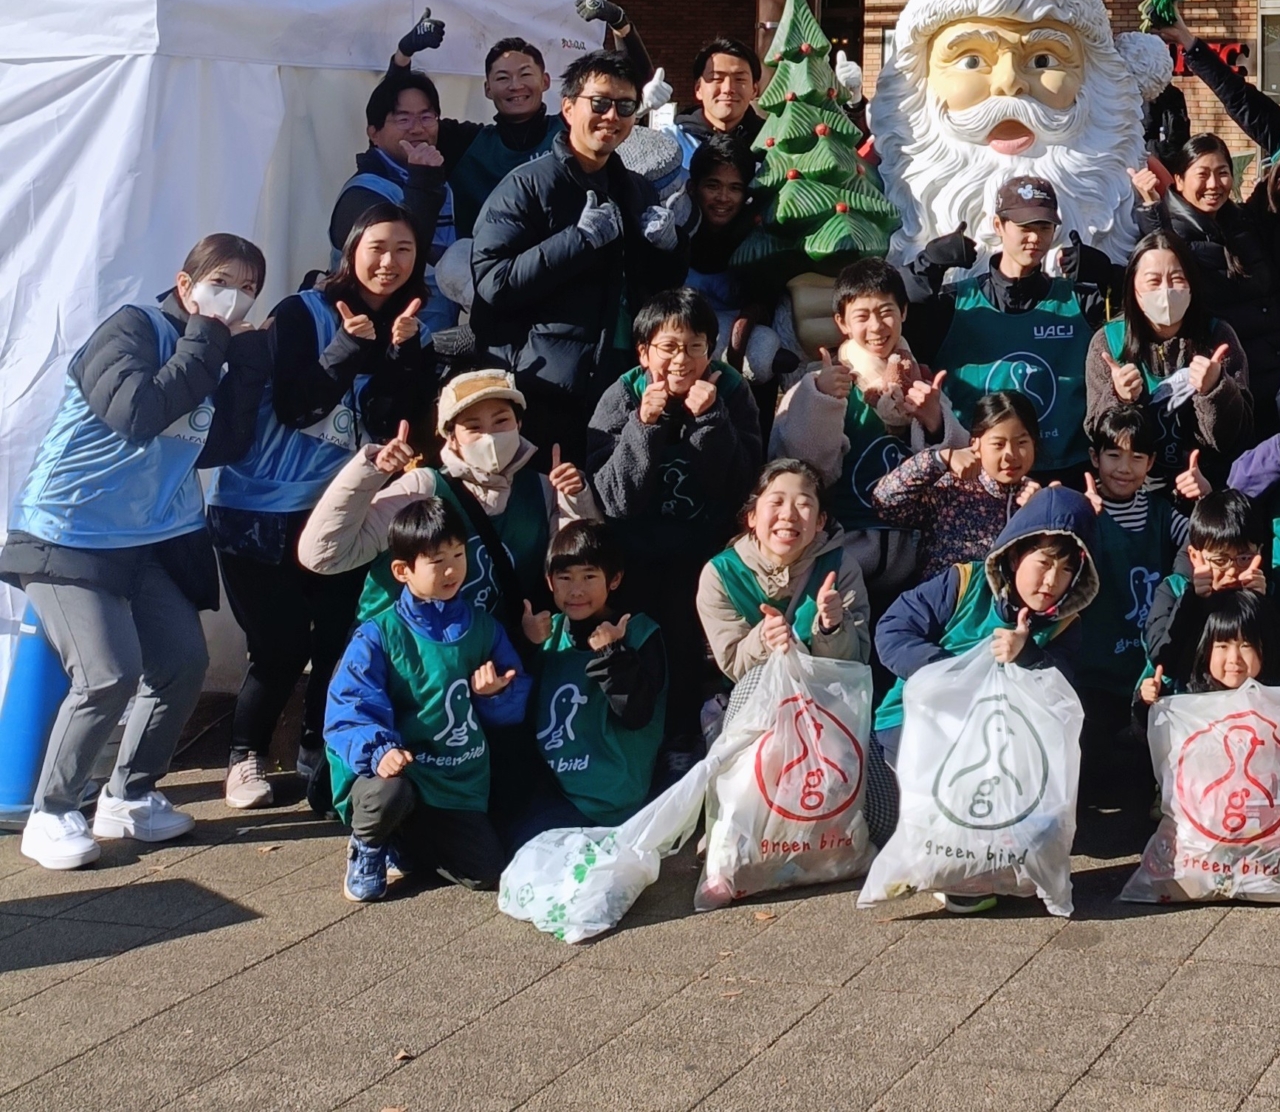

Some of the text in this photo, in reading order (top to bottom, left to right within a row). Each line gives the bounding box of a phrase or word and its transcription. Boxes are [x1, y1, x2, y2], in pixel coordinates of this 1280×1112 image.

[1033, 325, 1074, 339] UACJ
[1039, 428, 1059, 439] ird
[1114, 638, 1140, 654] gre
[556, 754, 590, 773] bird
[760, 830, 855, 854] green bird
[925, 840, 1029, 865] green bird
[1182, 854, 1232, 873] green
